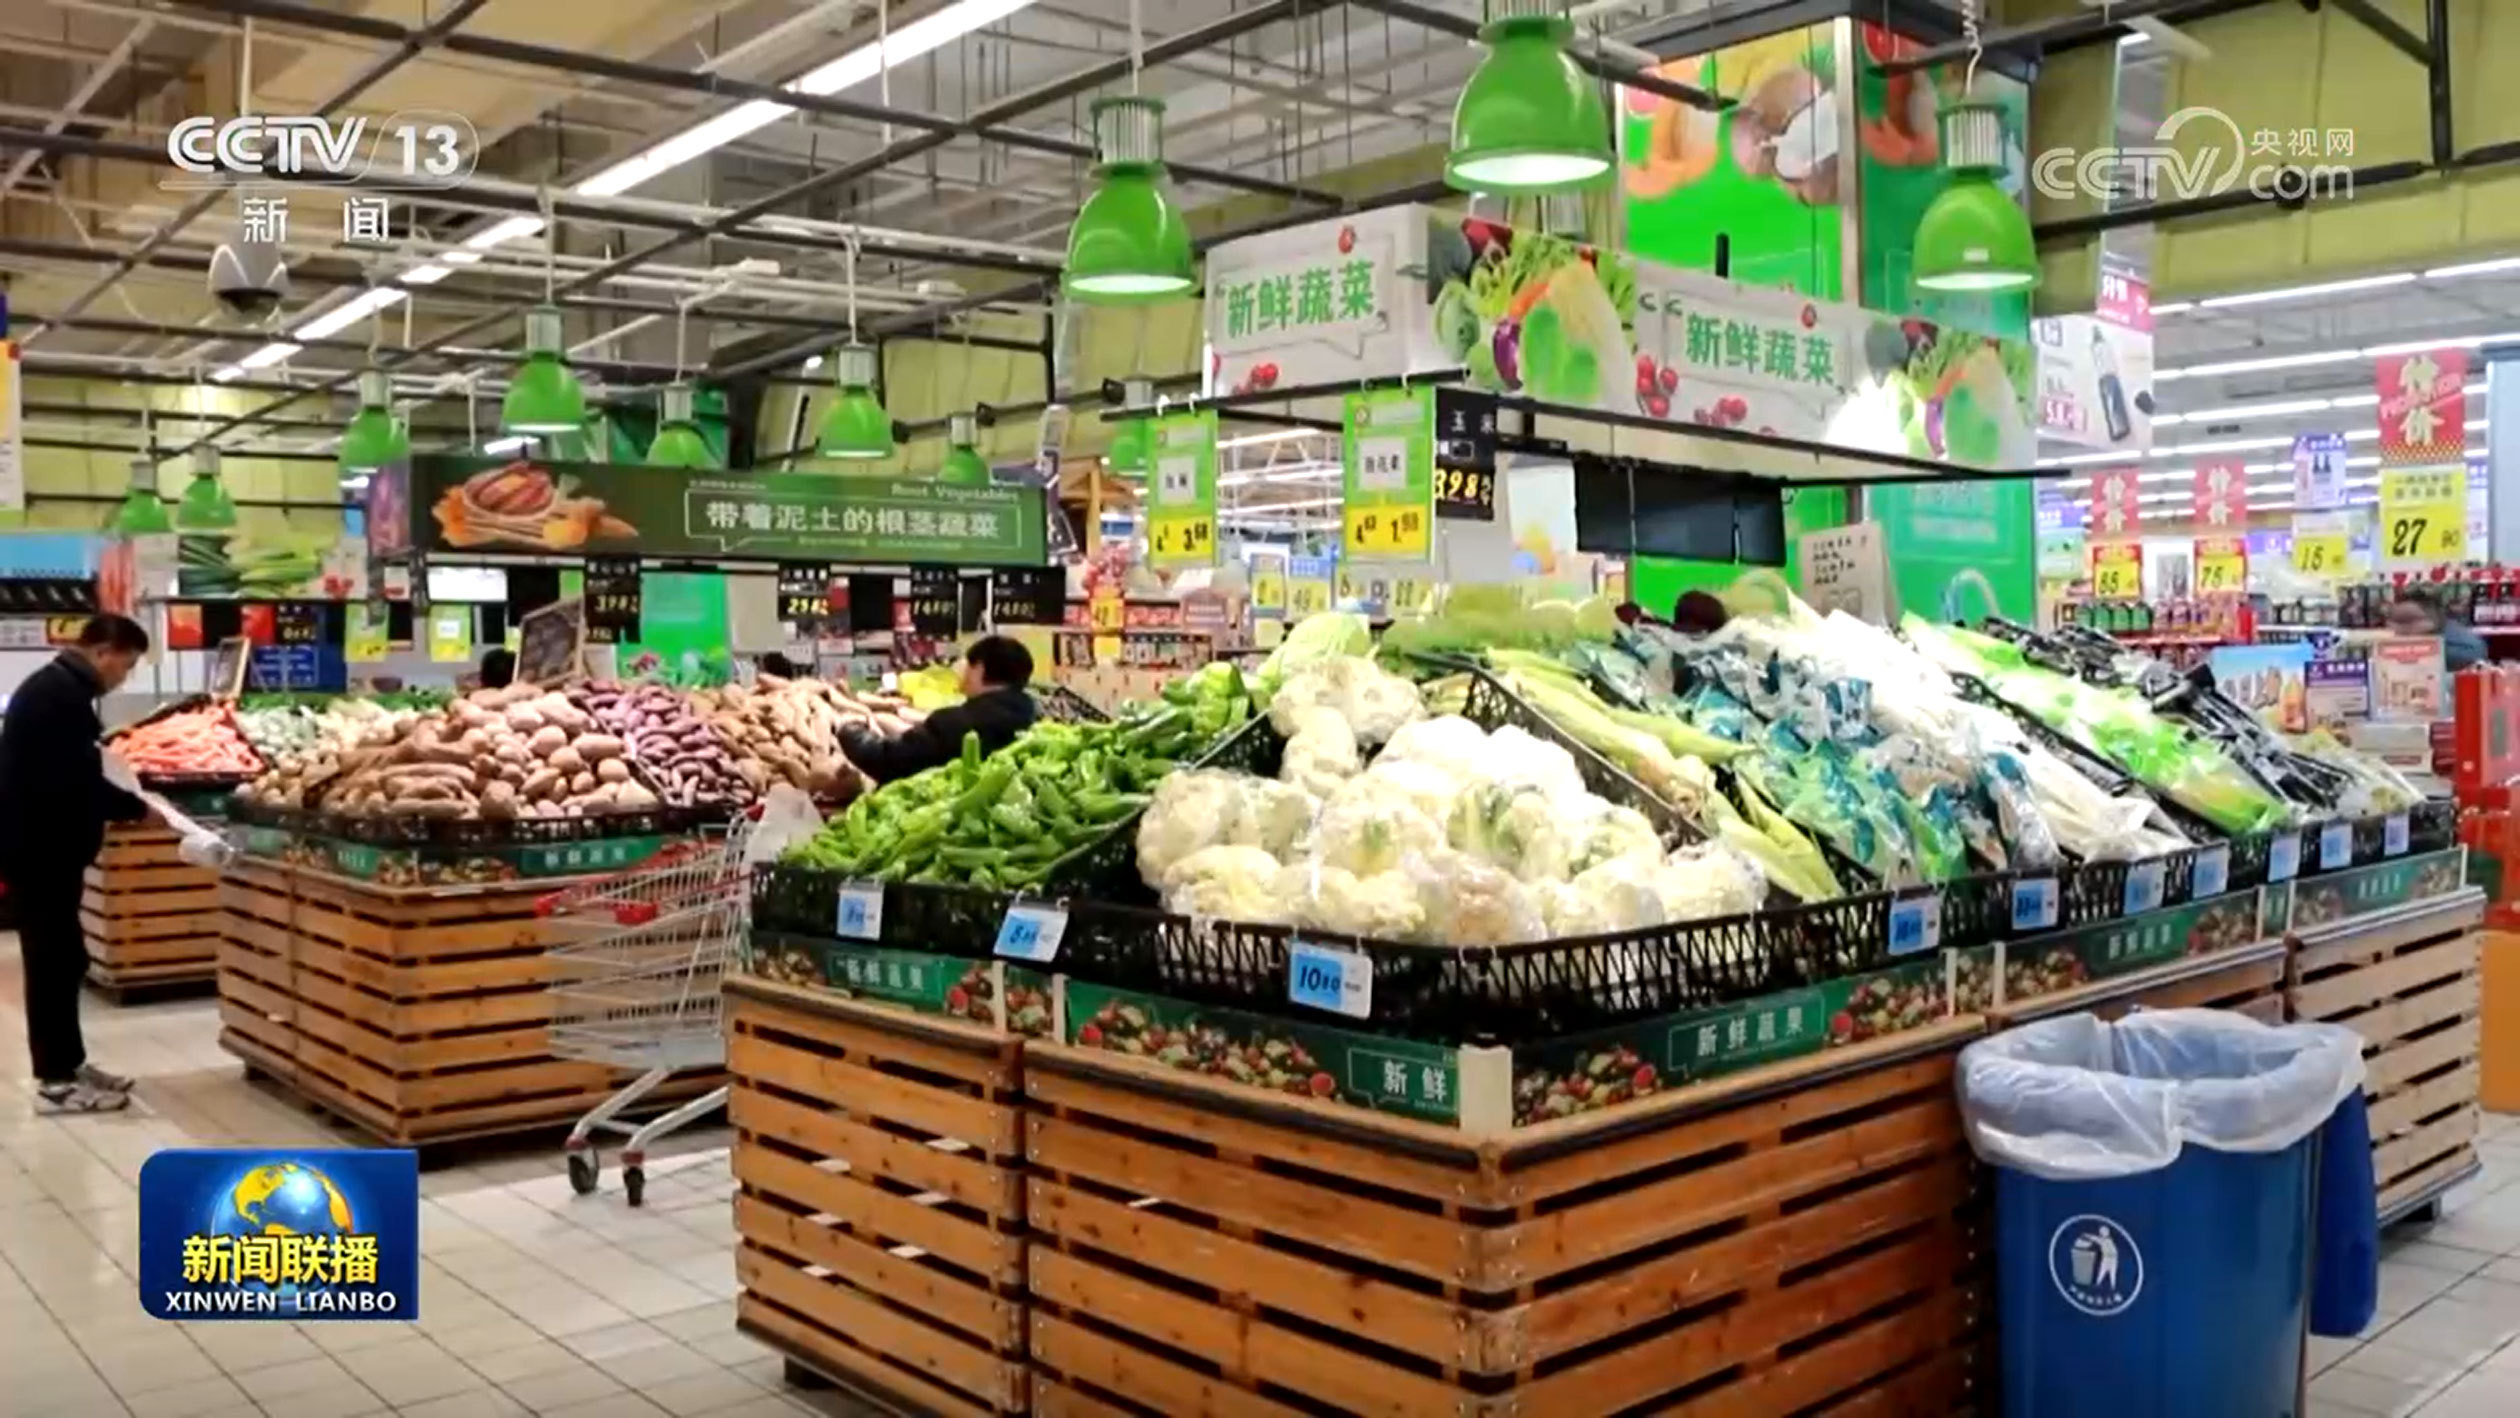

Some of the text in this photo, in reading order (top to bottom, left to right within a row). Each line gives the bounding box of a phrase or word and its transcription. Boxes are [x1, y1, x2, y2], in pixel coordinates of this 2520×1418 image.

[1226, 258, 1376, 340] 新鲜蔬菜
[1685, 311, 1836, 387] 新鲜蔬菜
[706, 501, 999, 540] 带着泥土的根茎蔬菜
[1697, 1004, 1803, 1057] 新鲜蔬果
[1383, 1058, 1447, 1104] 新鲜
